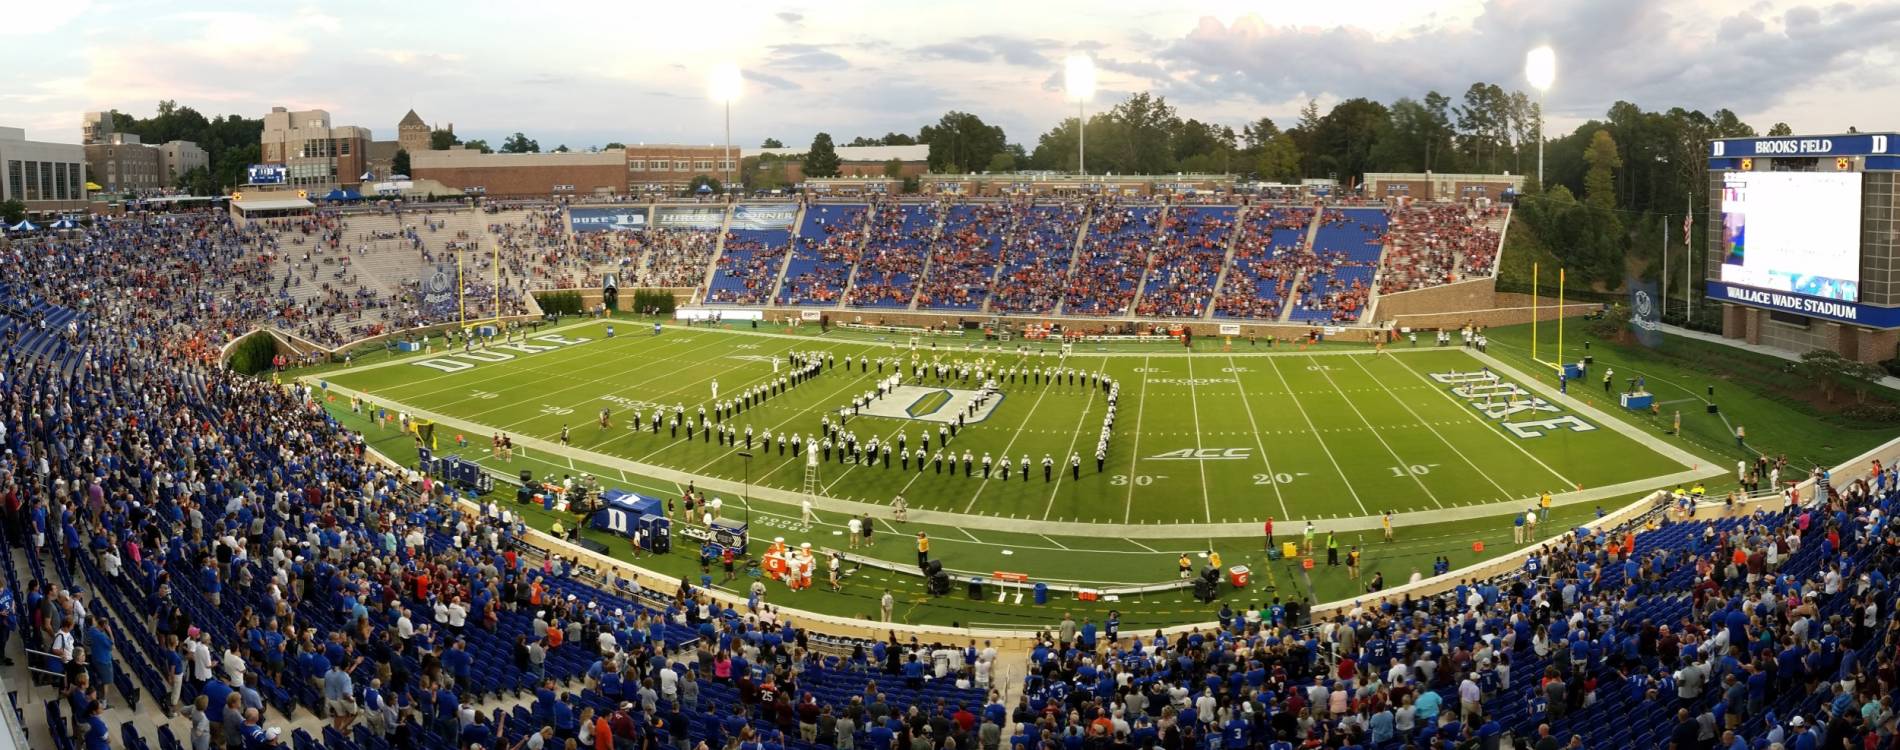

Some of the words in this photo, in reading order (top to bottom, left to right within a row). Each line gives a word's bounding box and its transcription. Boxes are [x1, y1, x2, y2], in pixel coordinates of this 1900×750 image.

[1713, 141, 1725, 156] D
[1755, 139, 1798, 154] BROOKS
[1800, 138, 1832, 153] FIELD
[1871, 135, 1888, 154] D
[1726, 286, 1771, 305] WALLACE
[1772, 293, 1802, 309] WADE
[1804, 298, 1857, 319] STADIUM
[411, 334, 593, 373] DUKE
[1428, 370, 1598, 439] DUKE
[1151, 447, 1254, 458] ACC
[1386, 464, 1430, 477] 10
[1110, 474, 1153, 486] 30
[1252, 472, 1293, 485] 20
[607, 508, 628, 532] D
[769, 559, 779, 569] G
[1374, 648, 1384, 657] 77
[761, 689, 773, 702] 25
[1057, 688, 1064, 698] 3
[1233, 728, 1242, 739] 3
